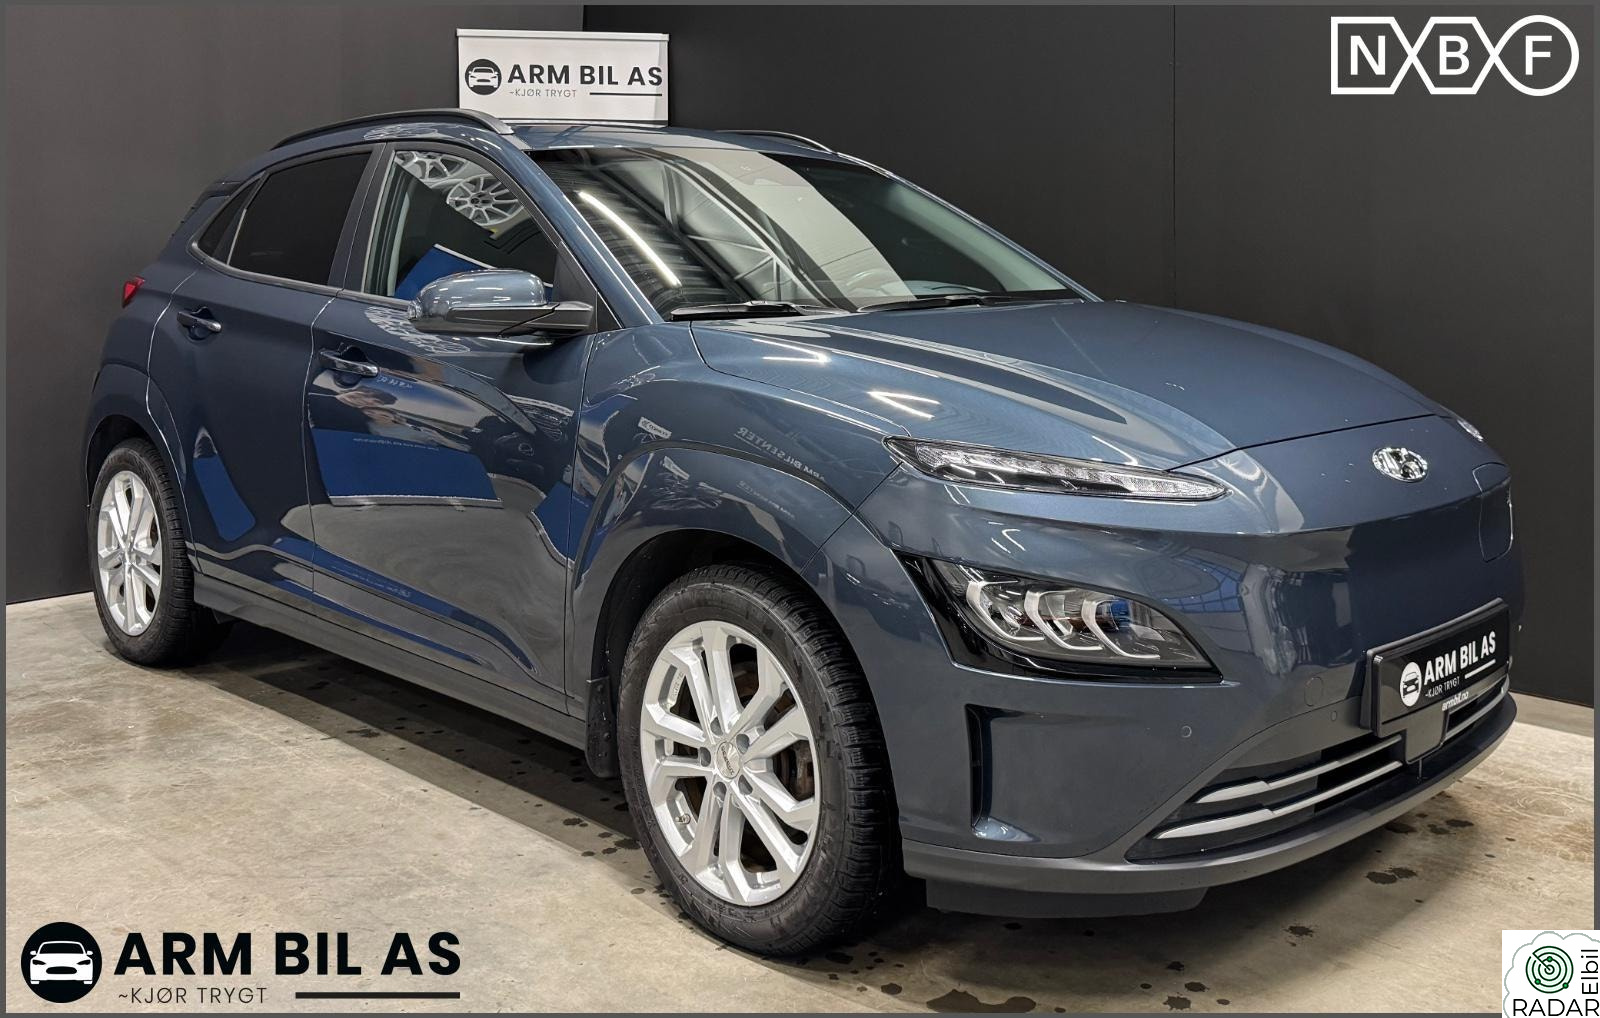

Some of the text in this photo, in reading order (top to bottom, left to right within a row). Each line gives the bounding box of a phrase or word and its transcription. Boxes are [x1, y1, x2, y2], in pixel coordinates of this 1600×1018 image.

[507, 64, 663, 86] ARM BIL AS
[546, 89, 577, 98] TRYGT
[1424, 631, 1496, 686] ARM BIL AS
